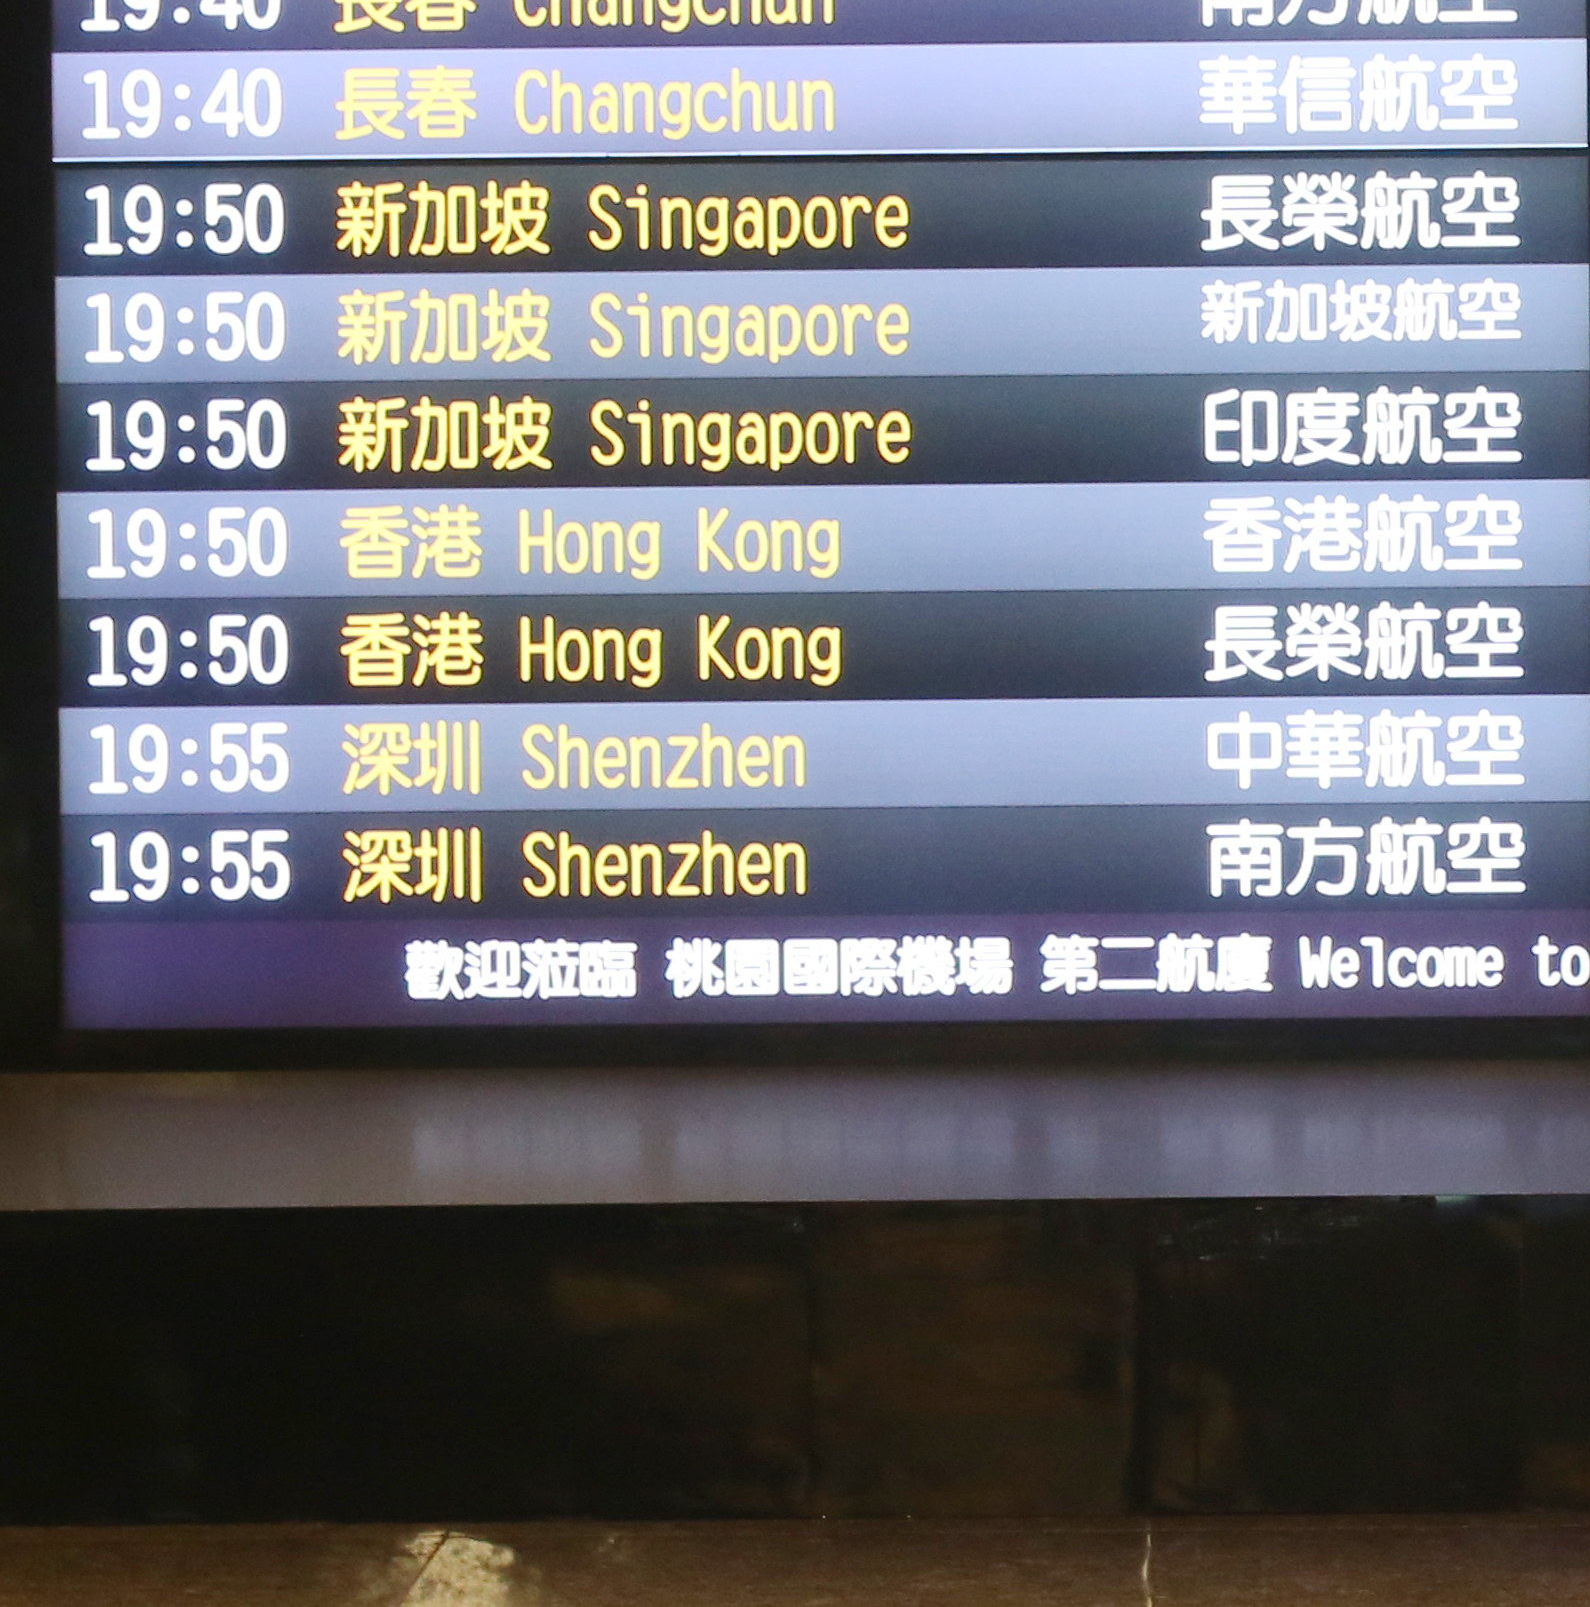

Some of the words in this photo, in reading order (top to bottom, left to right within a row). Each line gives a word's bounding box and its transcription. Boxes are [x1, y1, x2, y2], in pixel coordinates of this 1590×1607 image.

[1197, 51, 1520, 136] 華信航空
[83, 183, 285, 256] 19:50
[335, 179, 551, 258] 新加坡
[588, 183, 909, 257] Singapore
[1200, 169, 1521, 252] 長榮航空
[1200, 276, 1523, 345] 新加坡航空
[85, 398, 287, 471] 19:50
[338, 394, 553, 473] 新加坡
[590, 399, 911, 473] Singapore
[1203, 385, 1523, 468] 印度航空
[1201, 492, 1524, 574] 香港航空
[87, 614, 289, 687] 19:50
[339, 610, 484, 687] 香港
[519, 615, 662, 689] Hong
[698, 614, 841, 687] Kong
[1204, 600, 1525, 682] 長榮航空
[89, 829, 291, 903] 19:55
[341, 826, 481, 904] 深圳
[522, 829, 806, 898] Shenzhen
[1205, 815, 1527, 898] 南方航空
[403, 937, 639, 1001] 歡迎蒞臨
[664, 934, 1015, 999] 桃園國際機場
[1038, 931, 1274, 996] 第二航廈
[1298, 934, 1505, 990] Welcome
